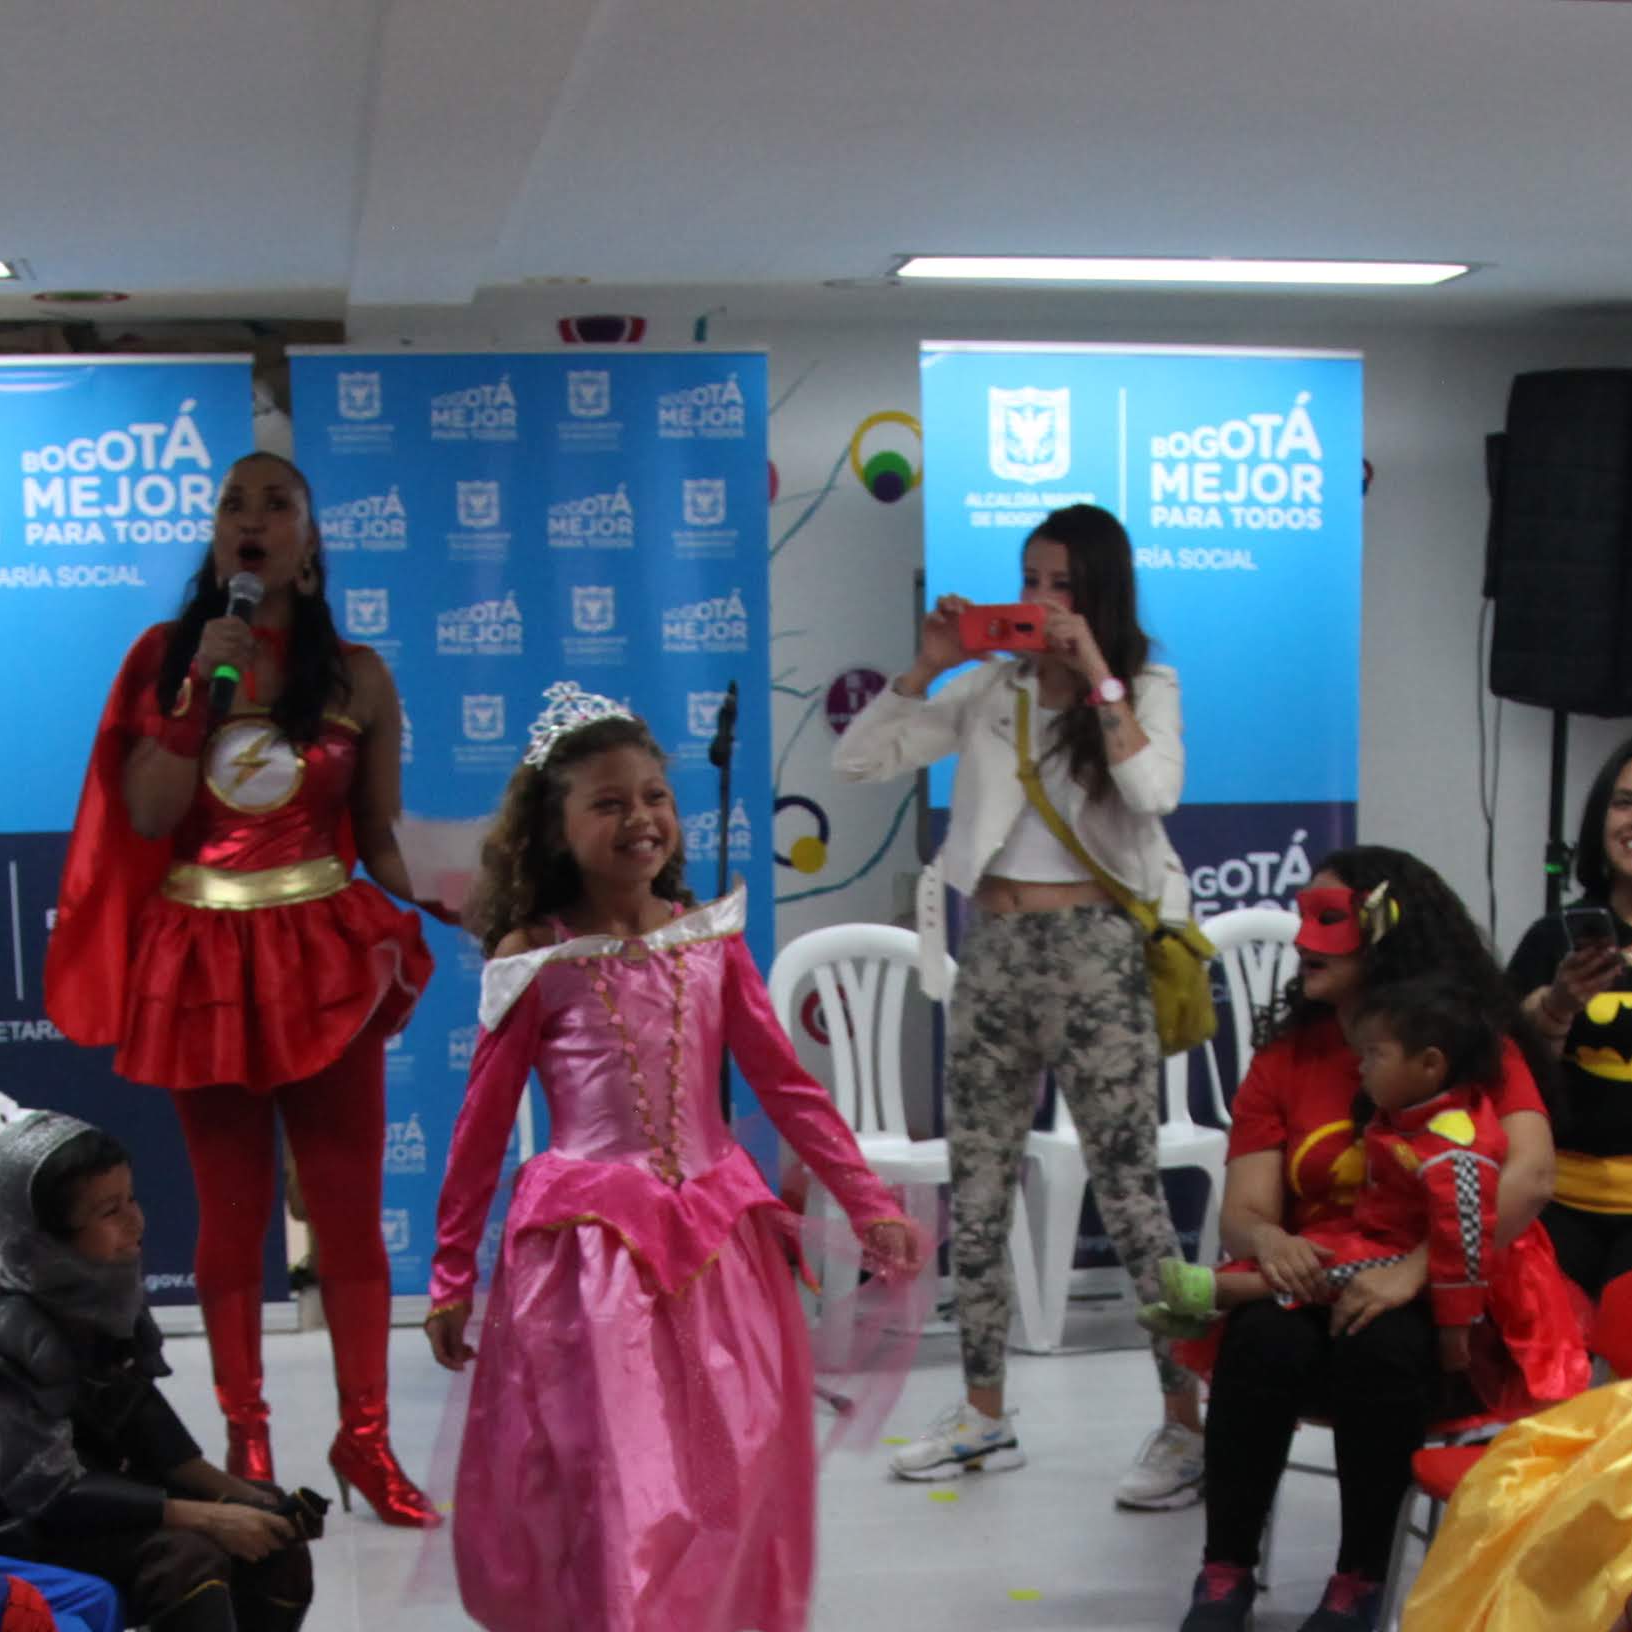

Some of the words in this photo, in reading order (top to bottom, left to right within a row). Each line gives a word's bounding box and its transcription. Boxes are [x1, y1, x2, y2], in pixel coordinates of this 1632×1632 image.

[431, 408, 516, 428] MEJOR
[658, 406, 745, 426] MEJOR
[1151, 391, 1324, 461] BOGOTÁ
[22, 399, 211, 472] BOGOTÁ
[1151, 462, 1324, 504] MEJOR
[23, 474, 215, 517] MEJOR
[320, 519, 406, 538] MEJOR
[548, 516, 633, 535] MEJOR
[1151, 505, 1223, 528] PARA
[1231, 506, 1324, 530] TODOS
[26, 522, 105, 545] PARA
[111, 519, 215, 543] TODOS
[1178, 547, 1259, 570] SOCIAL
[56, 565, 147, 587] SOCIAL
[437, 624, 522, 643] MEJOR
[663, 621, 748, 640] MEJOR
[1191, 829, 1311, 897] GOTÁ
